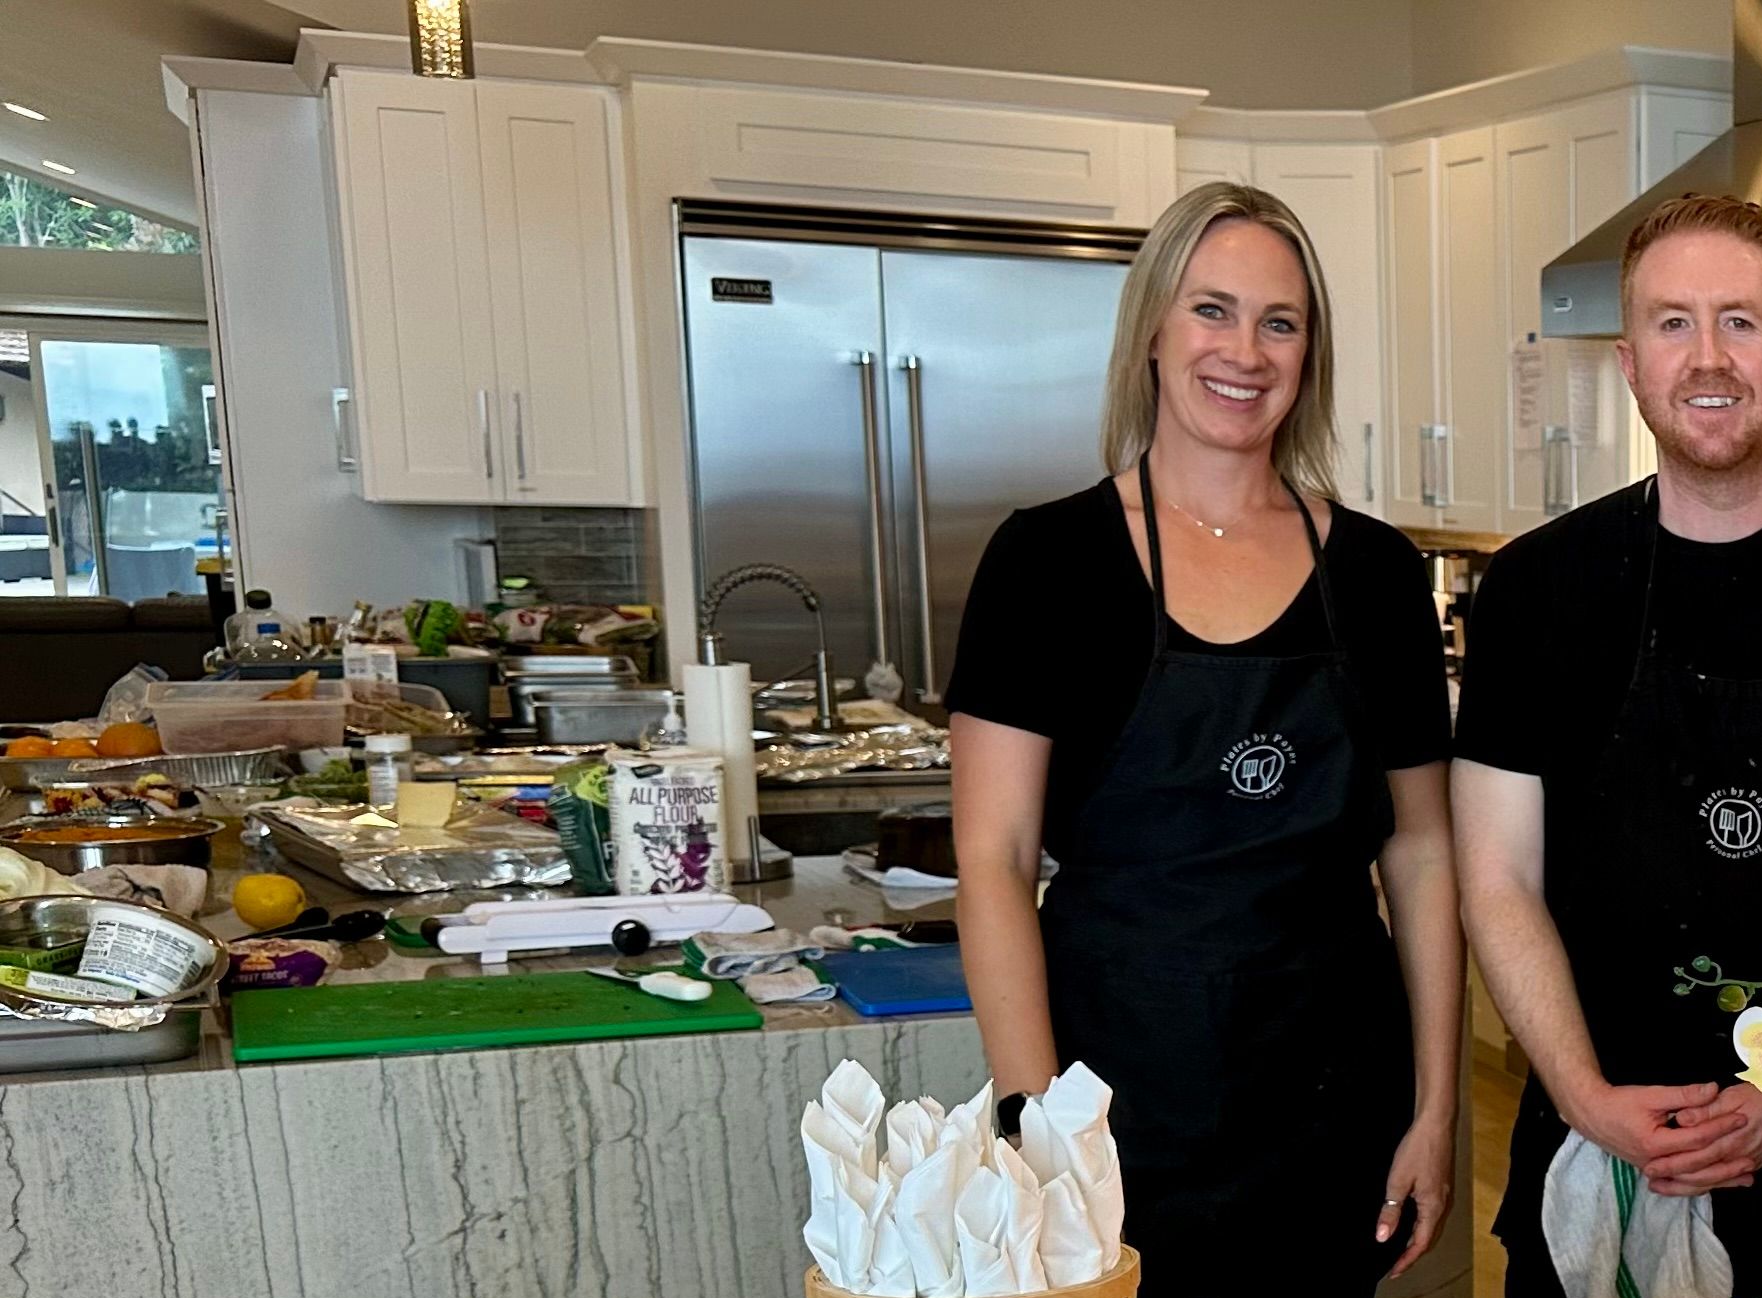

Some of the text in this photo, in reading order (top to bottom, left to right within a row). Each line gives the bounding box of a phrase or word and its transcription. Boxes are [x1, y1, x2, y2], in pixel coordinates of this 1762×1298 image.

[1253, 733, 1268, 743] by
[629, 785, 719, 805] ALL PURPOSE
[1730, 786, 1745, 798] by
[654, 805, 699, 824] FLOUR
